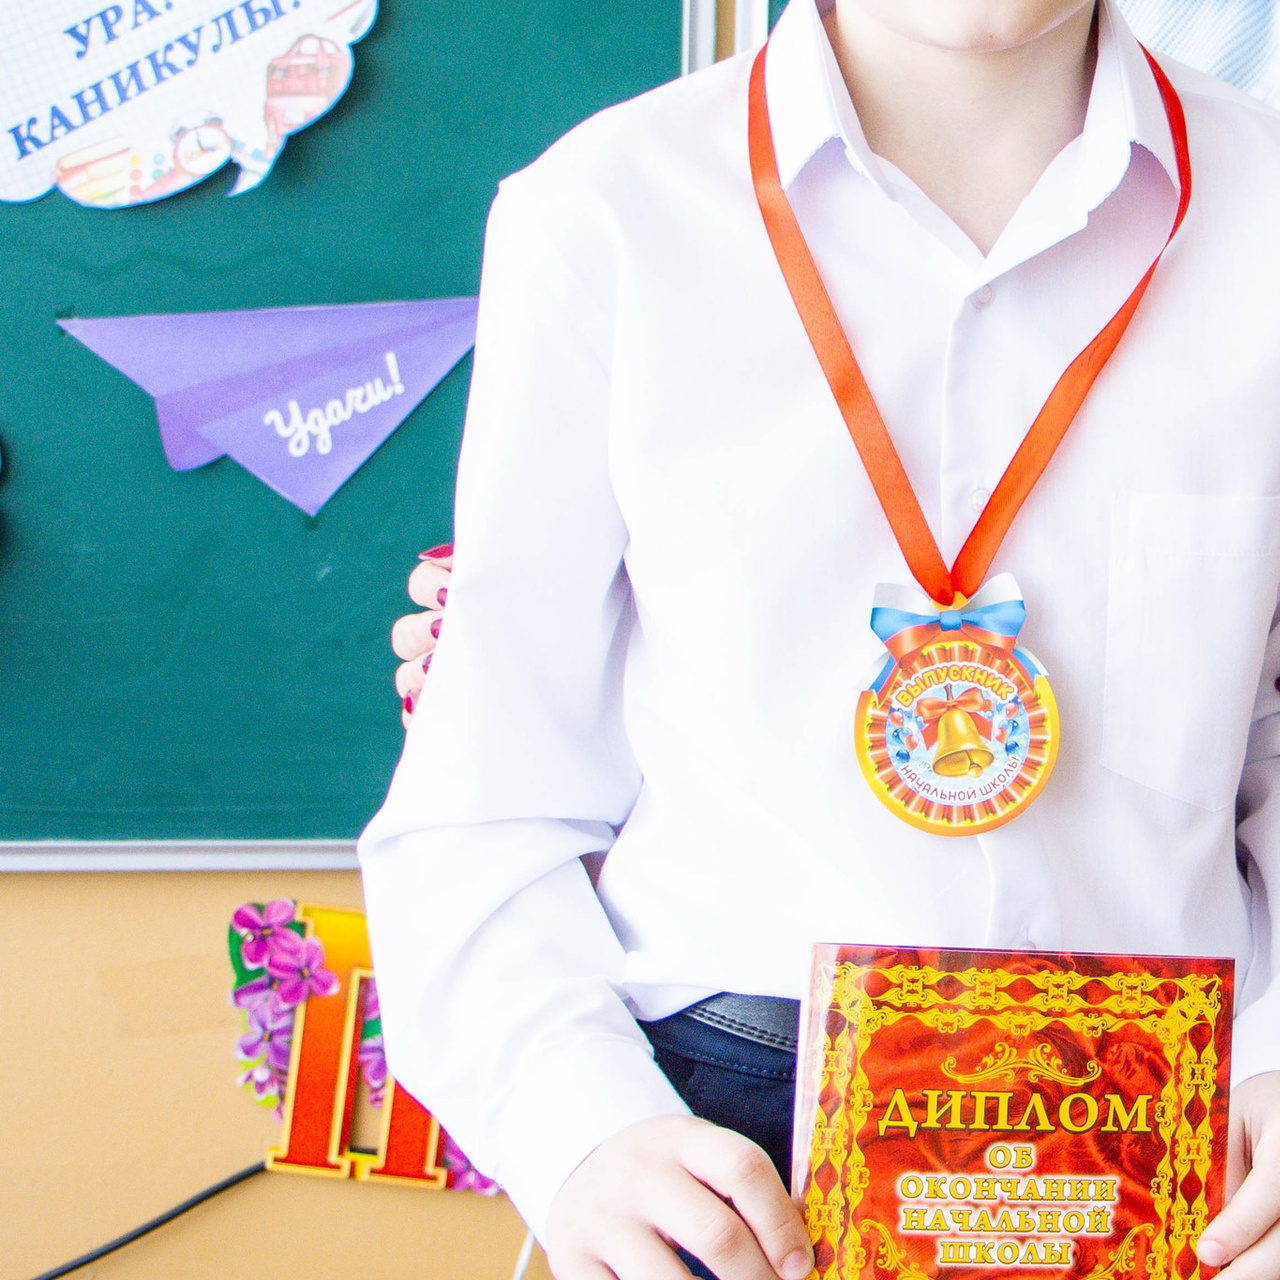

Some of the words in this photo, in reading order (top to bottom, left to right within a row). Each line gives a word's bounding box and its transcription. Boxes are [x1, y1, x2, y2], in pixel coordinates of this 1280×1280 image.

[263, 350, 406, 459] Удачи!
[895, 664, 1015, 708] ВЫПУСКНИК
[900, 764, 978, 803] НАЧАЛЬНОЙ
[980, 755, 1021, 797] ШКОЛЫ
[877, 1086, 1154, 1139] ДИПЛОМ
[987, 1145, 1033, 1170] ОБ
[899, 1175, 1117, 1203] ОКОНЧАНИИ
[901, 1205, 1111, 1234] НАЧАЛЬНОЙ
[938, 1240, 1073, 1266] ШКОЛЫ
